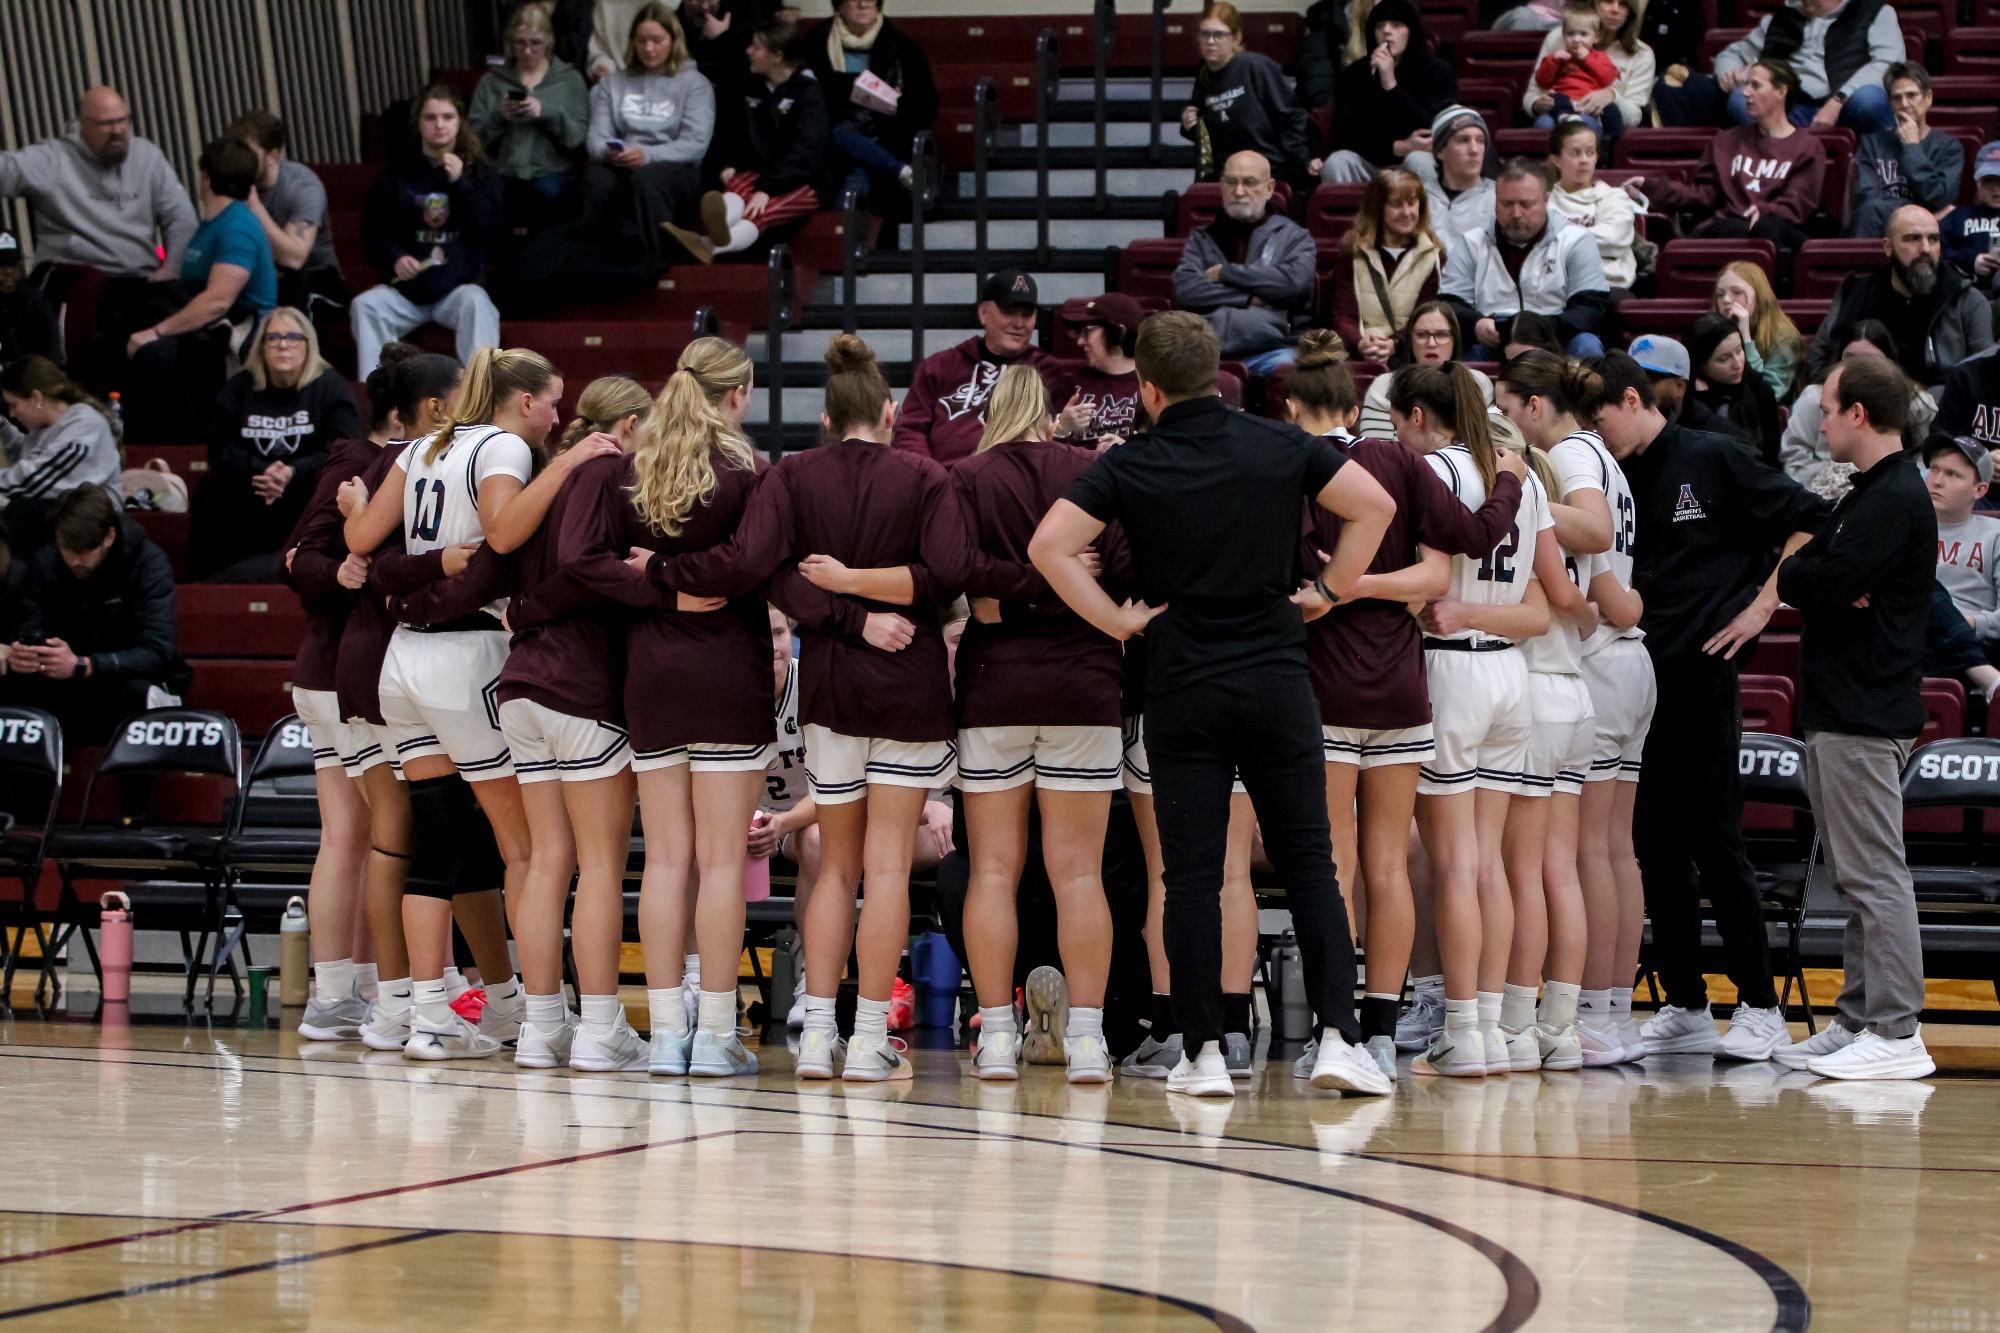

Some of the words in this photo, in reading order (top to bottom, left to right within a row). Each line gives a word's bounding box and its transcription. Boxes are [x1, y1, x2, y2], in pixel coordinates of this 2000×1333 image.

[1731, 153, 1792, 179] ALMA
[1011, 275, 1030, 293] A
[247, 410, 310, 430] SCOTS
[1676, 484, 1698, 509] A
[0, 718, 44, 744] TS
[127, 721, 223, 746] SCOTS
